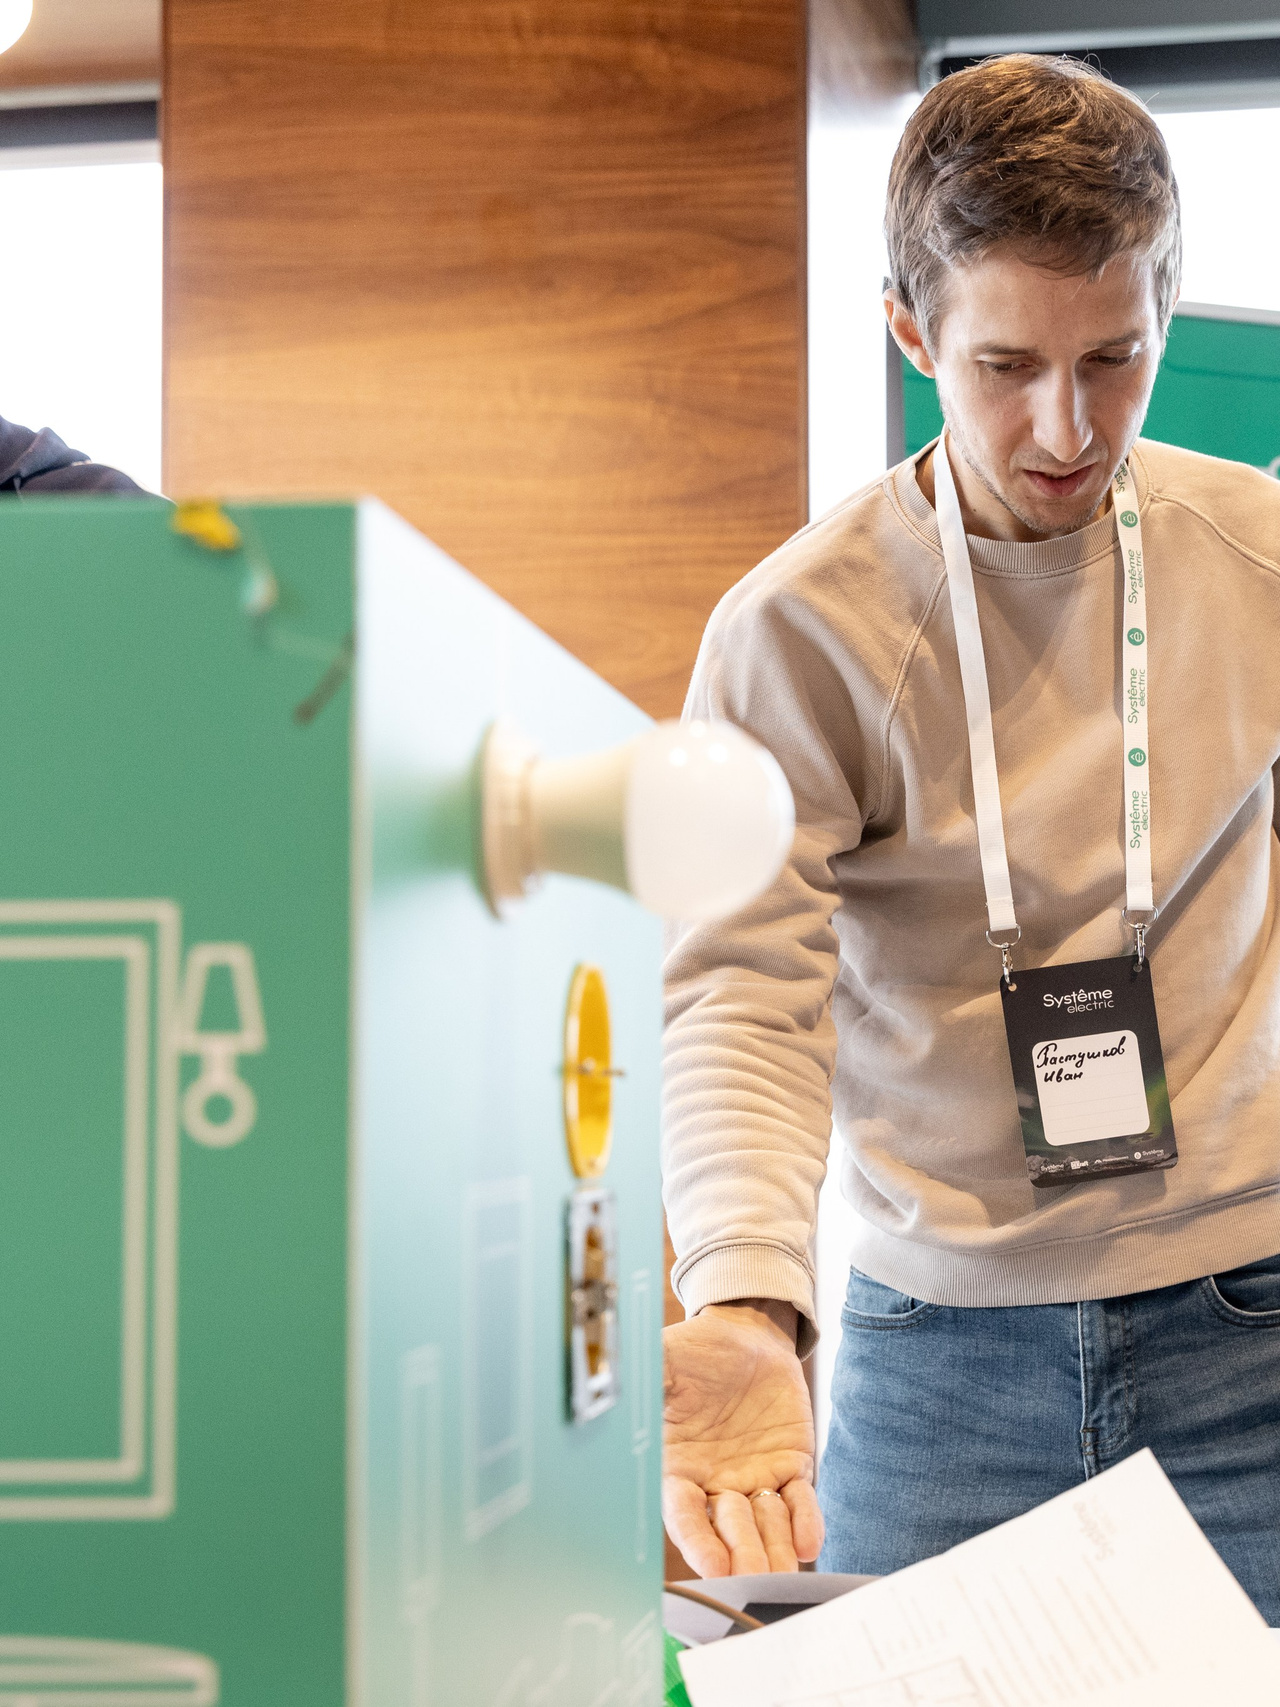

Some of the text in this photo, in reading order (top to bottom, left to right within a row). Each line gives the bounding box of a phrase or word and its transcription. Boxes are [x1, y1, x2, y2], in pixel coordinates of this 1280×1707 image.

[1127, 667, 1140, 725] Systême
[1137, 668, 1146, 708] electric
[1129, 789, 1142, 849] Systême
[1140, 790, 1149, 832] electric
[1042, 988, 1114, 1009] Systême
[1066, 999, 1115, 1014] electric
[1043, 1067, 1084, 1083] Иван
